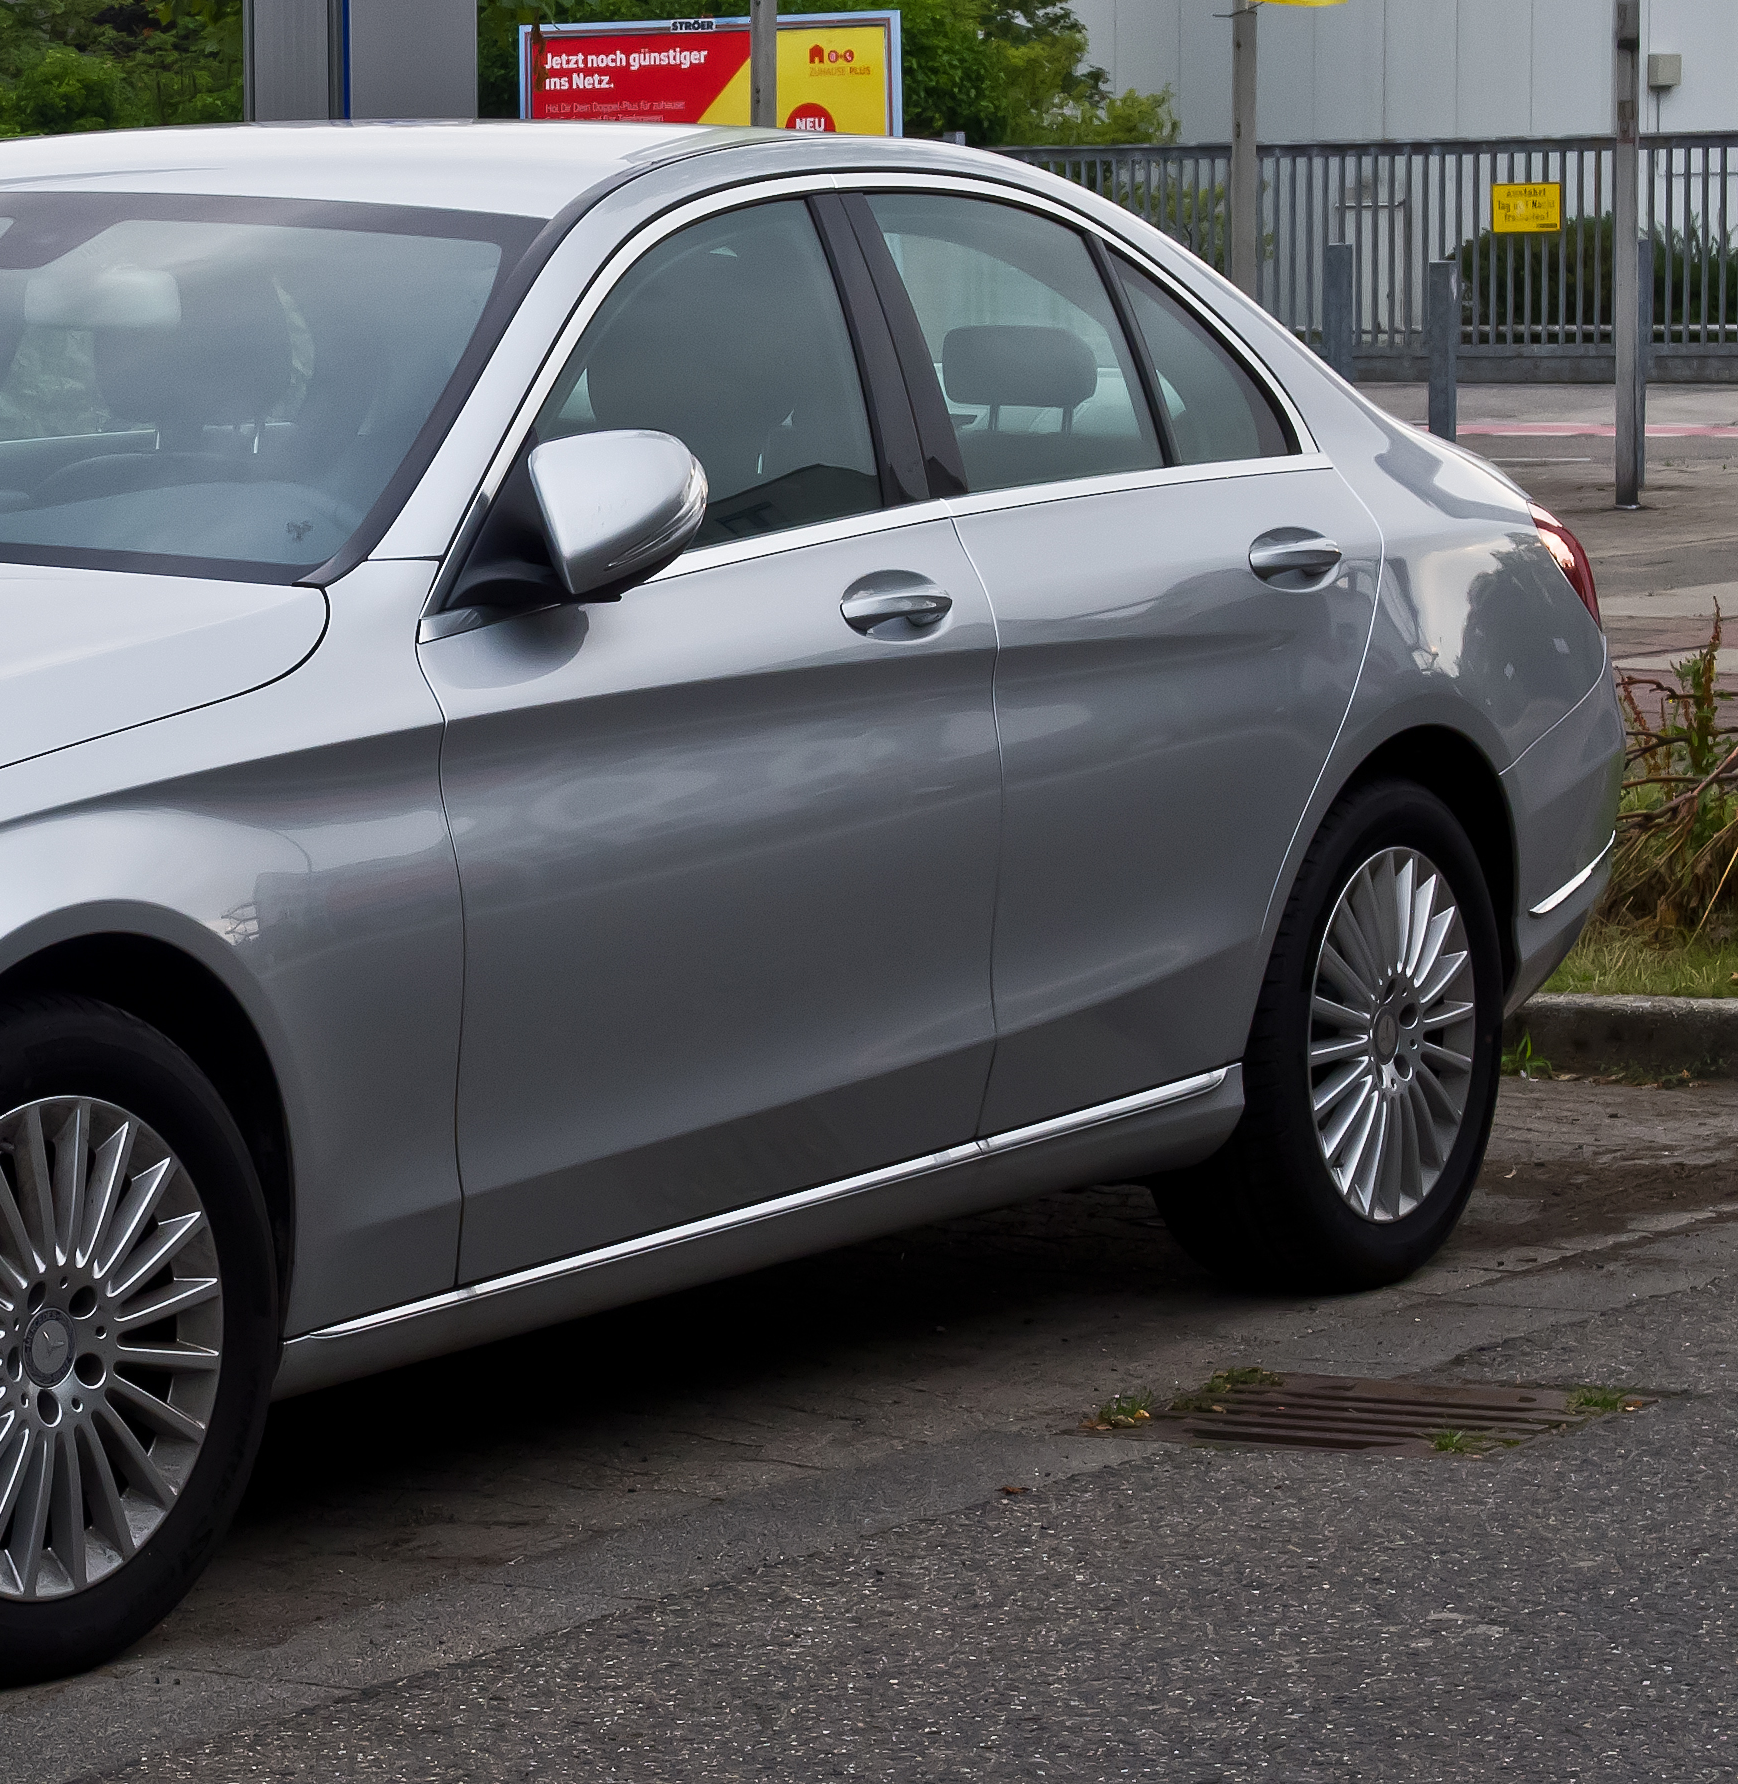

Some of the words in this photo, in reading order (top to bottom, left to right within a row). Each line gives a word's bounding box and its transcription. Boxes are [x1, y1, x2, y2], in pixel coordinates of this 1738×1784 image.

[672, 19, 713, 31] STRÖER
[545, 53, 584, 69] Jetzt
[588, 51, 626, 67] noch
[630, 48, 708, 71] günstiger
[849, 65, 871, 76] PLUS
[545, 78, 569, 90] ins
[572, 73, 614, 89] Netz.
[640, 99, 651, 111] für
[795, 117, 825, 132] NEU
